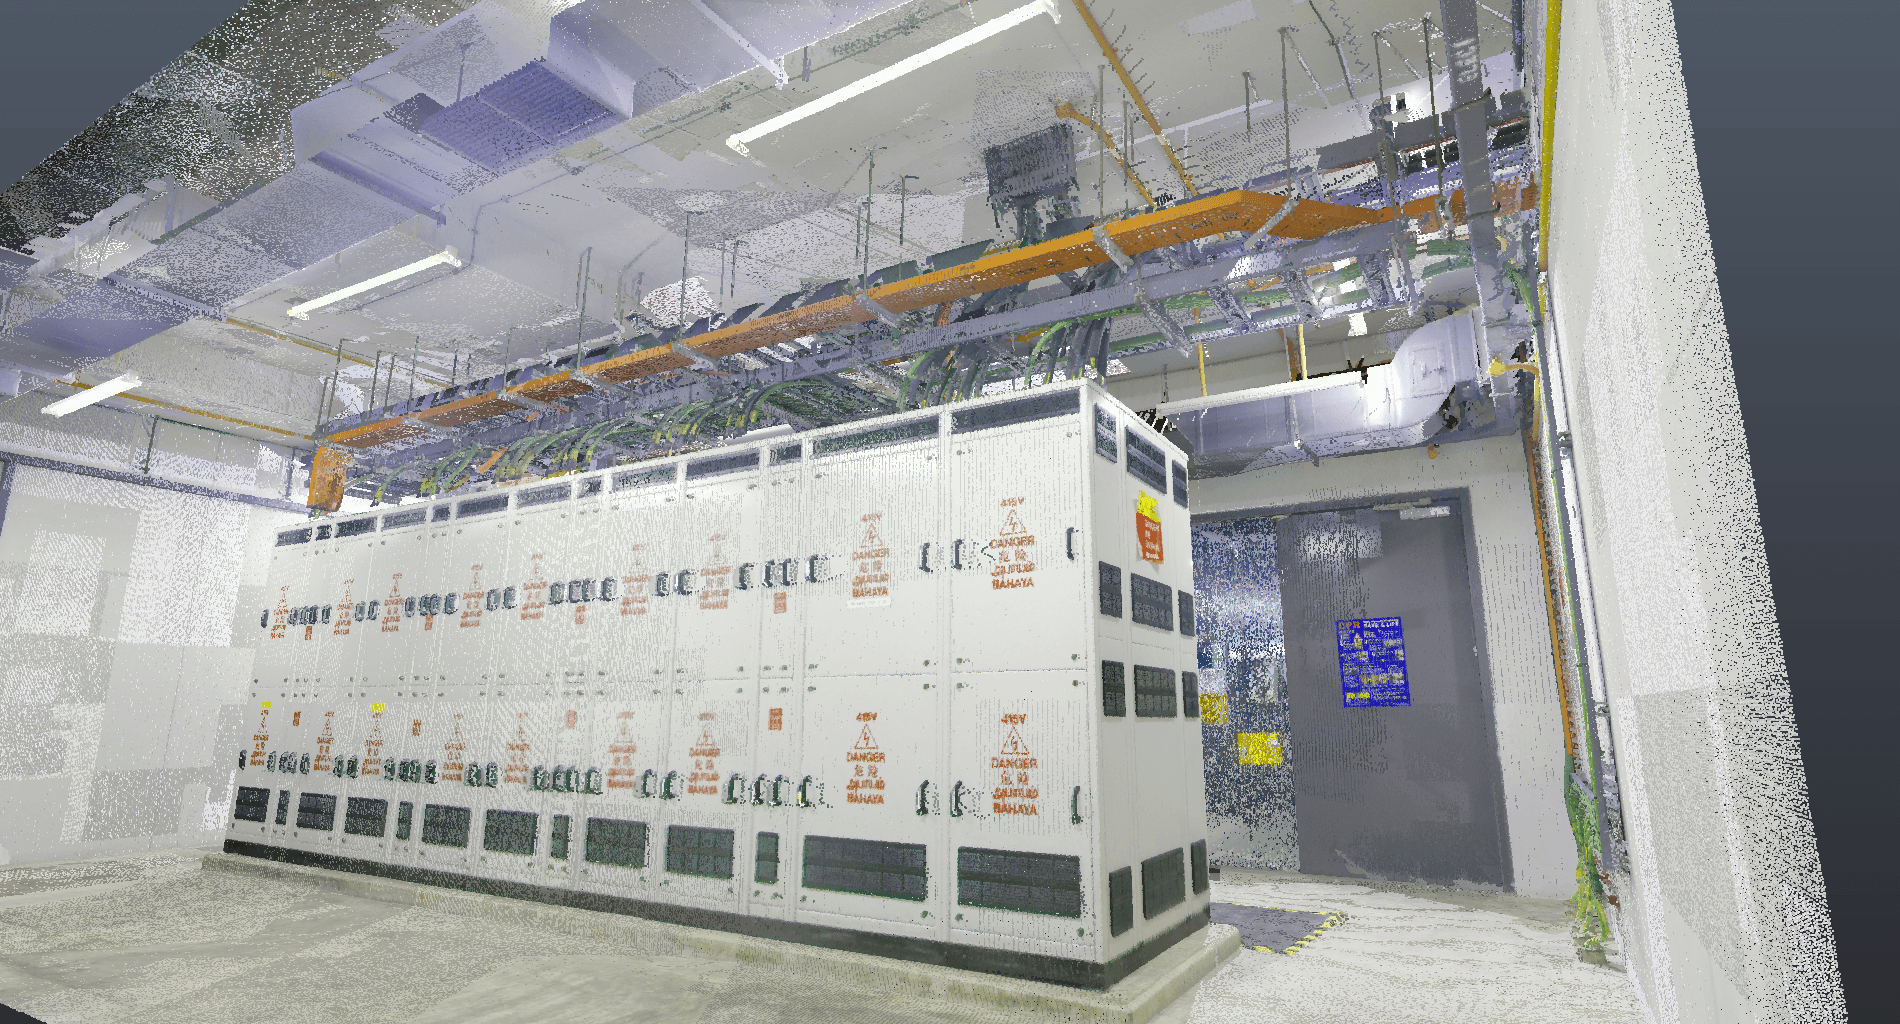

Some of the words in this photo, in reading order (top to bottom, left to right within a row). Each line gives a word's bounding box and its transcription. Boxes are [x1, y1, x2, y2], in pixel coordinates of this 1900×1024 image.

[990, 534, 1034, 550] DANGER
[852, 547, 890, 561] DANGER
[992, 577, 1034, 590] BAHAYA
[852, 585, 888, 599] BAHAYA
[1338, 621, 1361, 629] CPR
[1001, 714, 1026, 725] 415V
[846, 751, 885, 763] DANGER
[991, 757, 1038, 769] DANGER
[847, 792, 884, 804] BAHAYA
[993, 802, 1037, 815] BAHAYA
